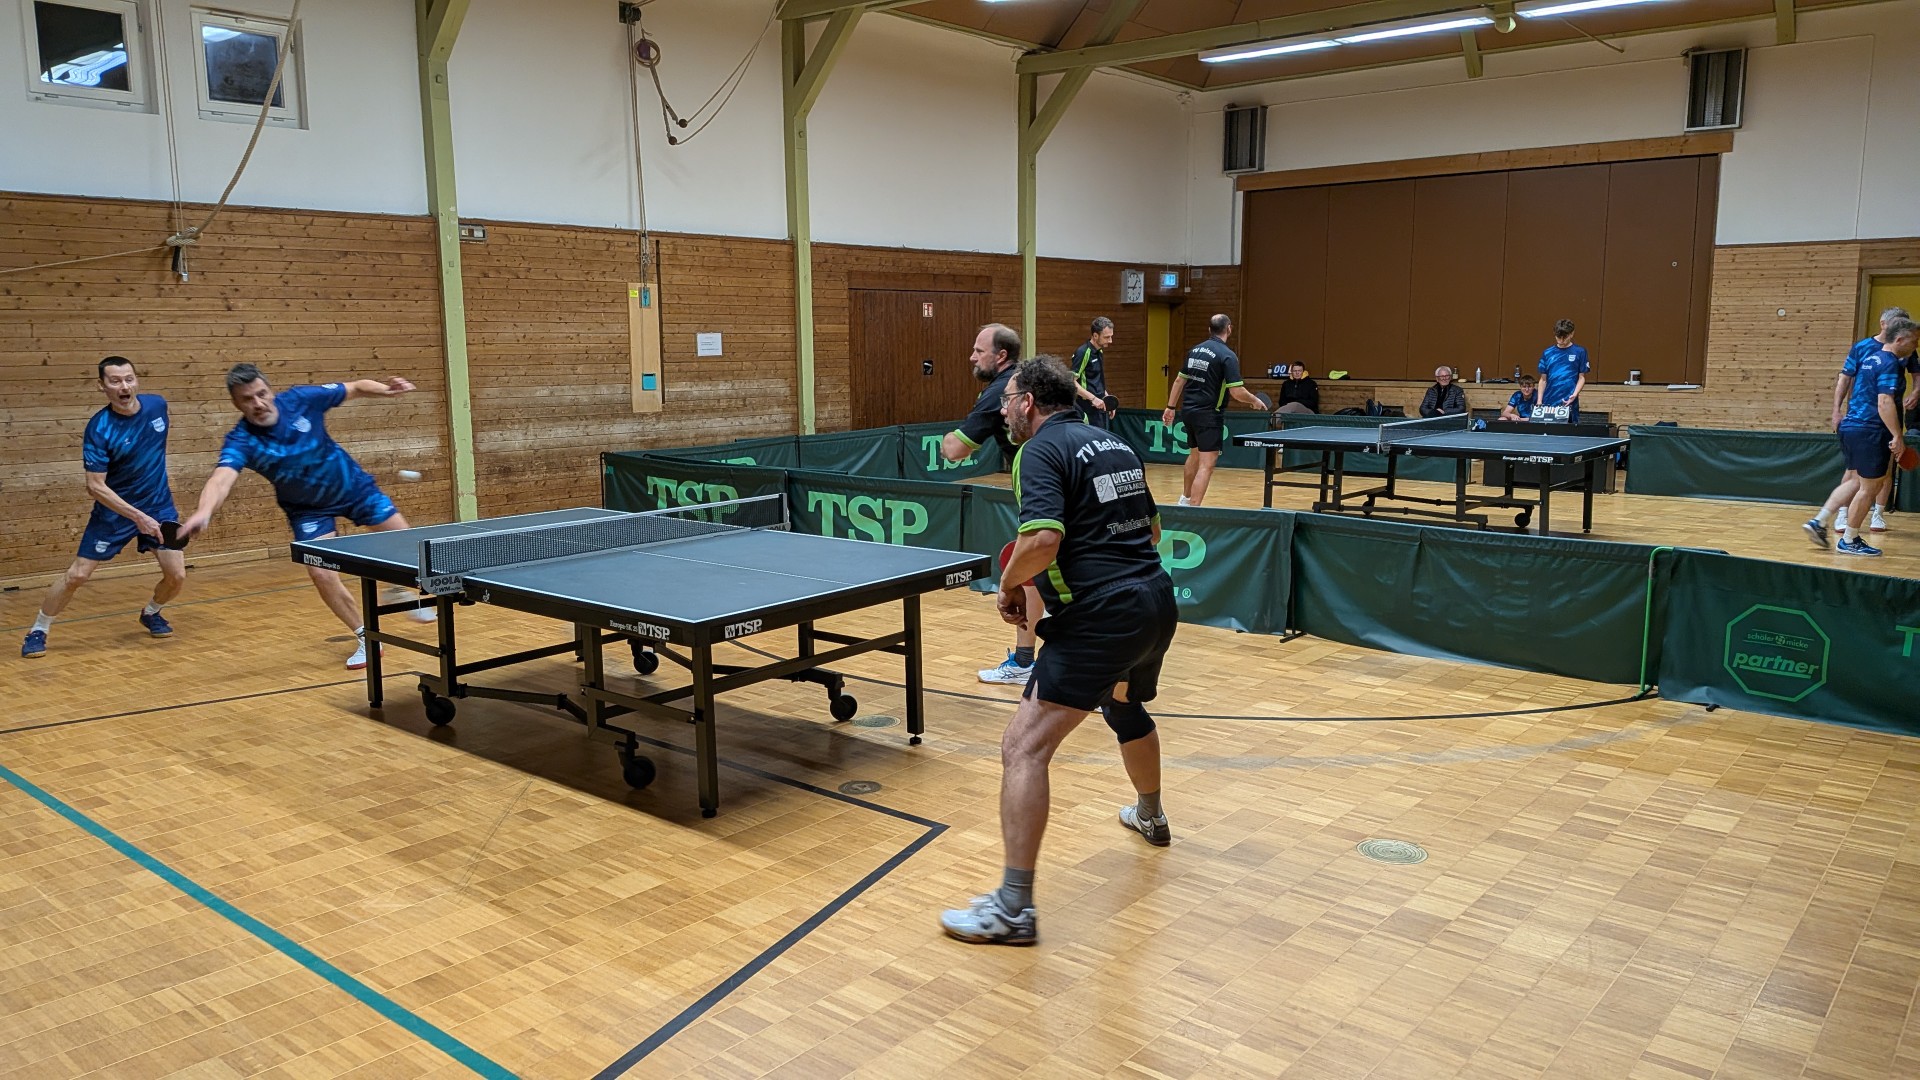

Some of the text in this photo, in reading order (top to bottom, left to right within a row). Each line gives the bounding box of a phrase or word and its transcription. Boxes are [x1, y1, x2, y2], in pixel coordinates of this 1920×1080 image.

[1533, 407, 1543, 417] 3
[1557, 407, 1566, 416] 6
[1145, 420, 1229, 454] TS
[1076, 443, 1095, 463] TV
[1536, 455, 1553, 463] TSP
[647, 476, 740, 524] TSP
[808, 491, 928, 546] TSP
[309, 554, 322, 567] TSP
[430, 575, 461, 588] JOOLA
[954, 569, 973, 584] TSP
[647, 623, 670, 640] TSP
[735, 618, 762, 636] TSP
[1747, 632, 1809, 649] schöler micke
[1732, 652, 1820, 675] partner
